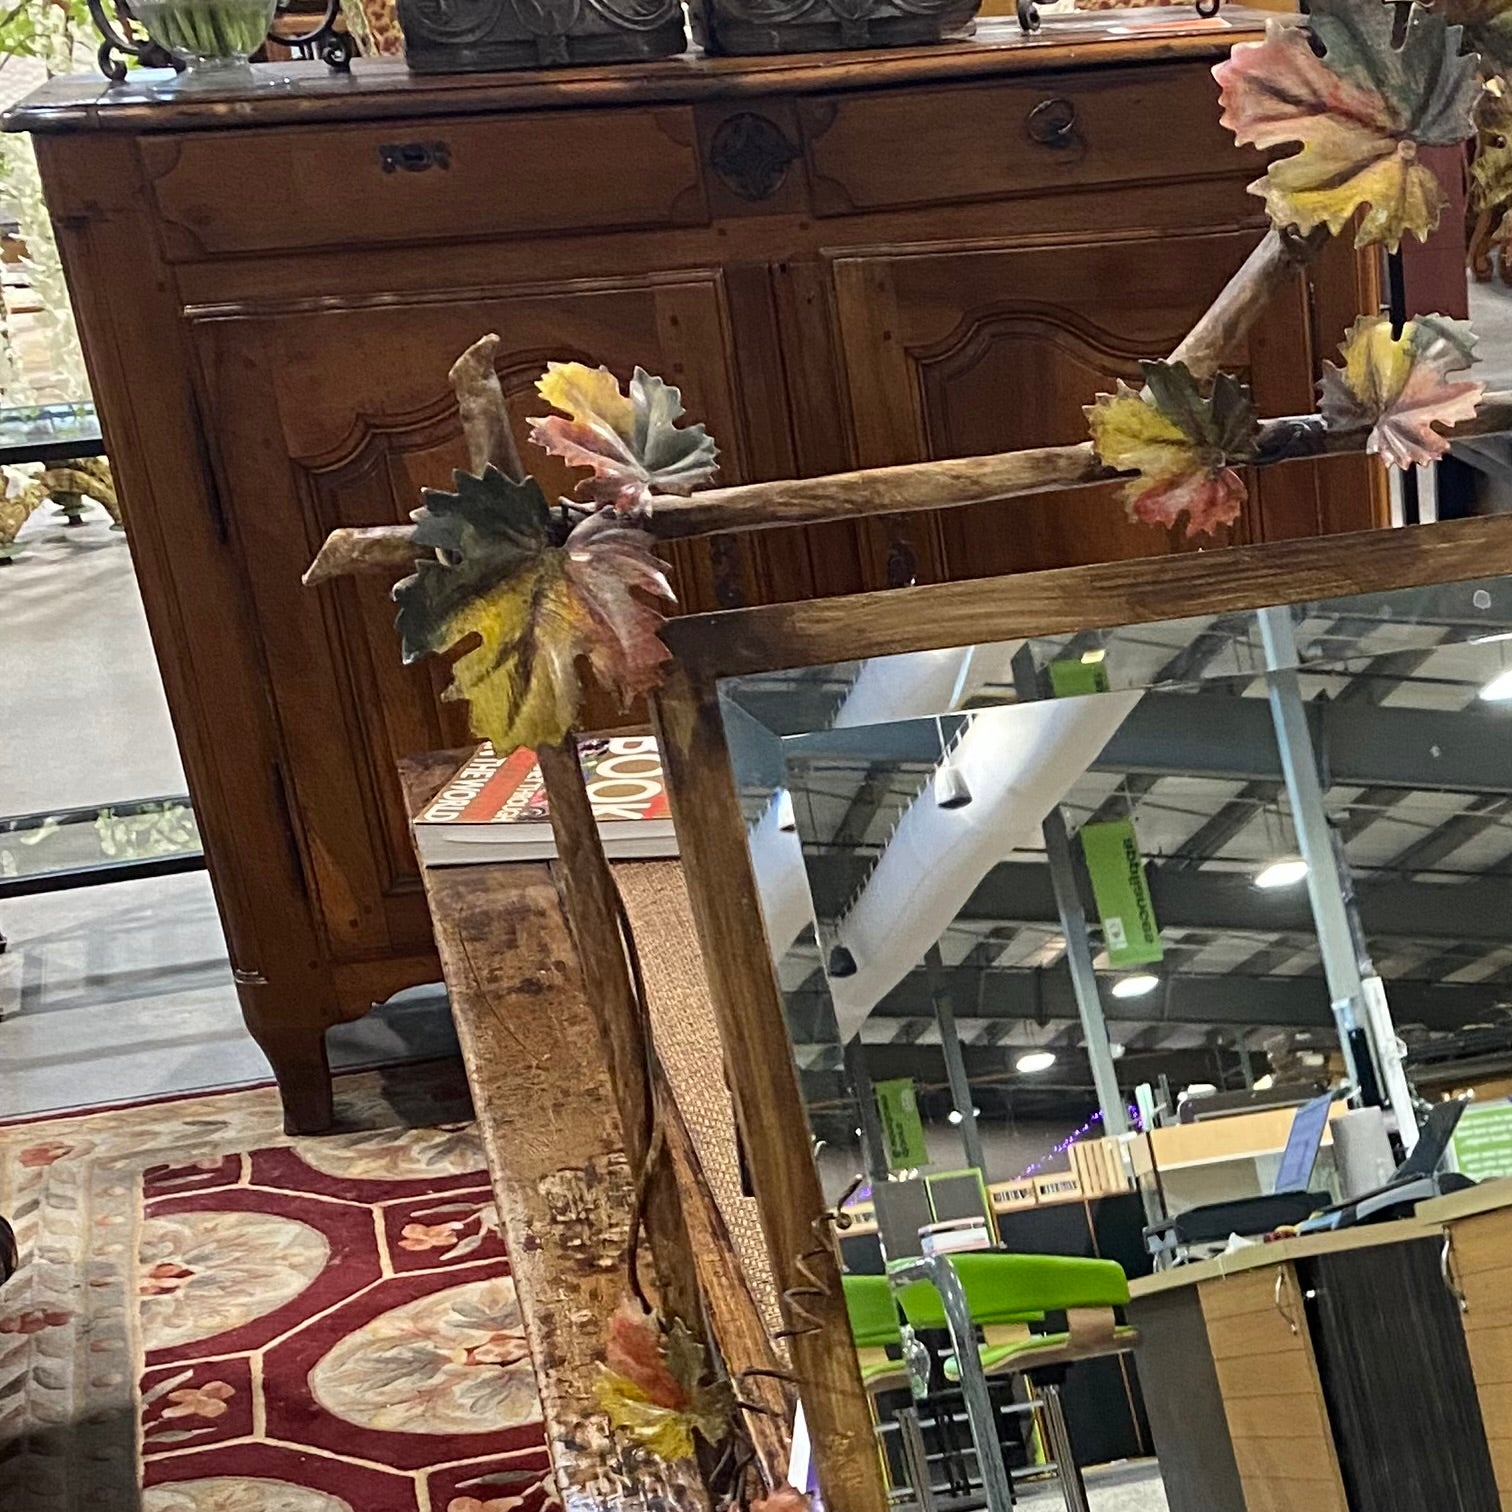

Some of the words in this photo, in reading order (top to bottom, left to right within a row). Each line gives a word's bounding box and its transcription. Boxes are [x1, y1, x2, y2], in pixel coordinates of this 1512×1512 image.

[460, 757, 508, 780] THE
[586, 736, 663, 819] BOOK
[424, 780, 485, 821] WORLD
